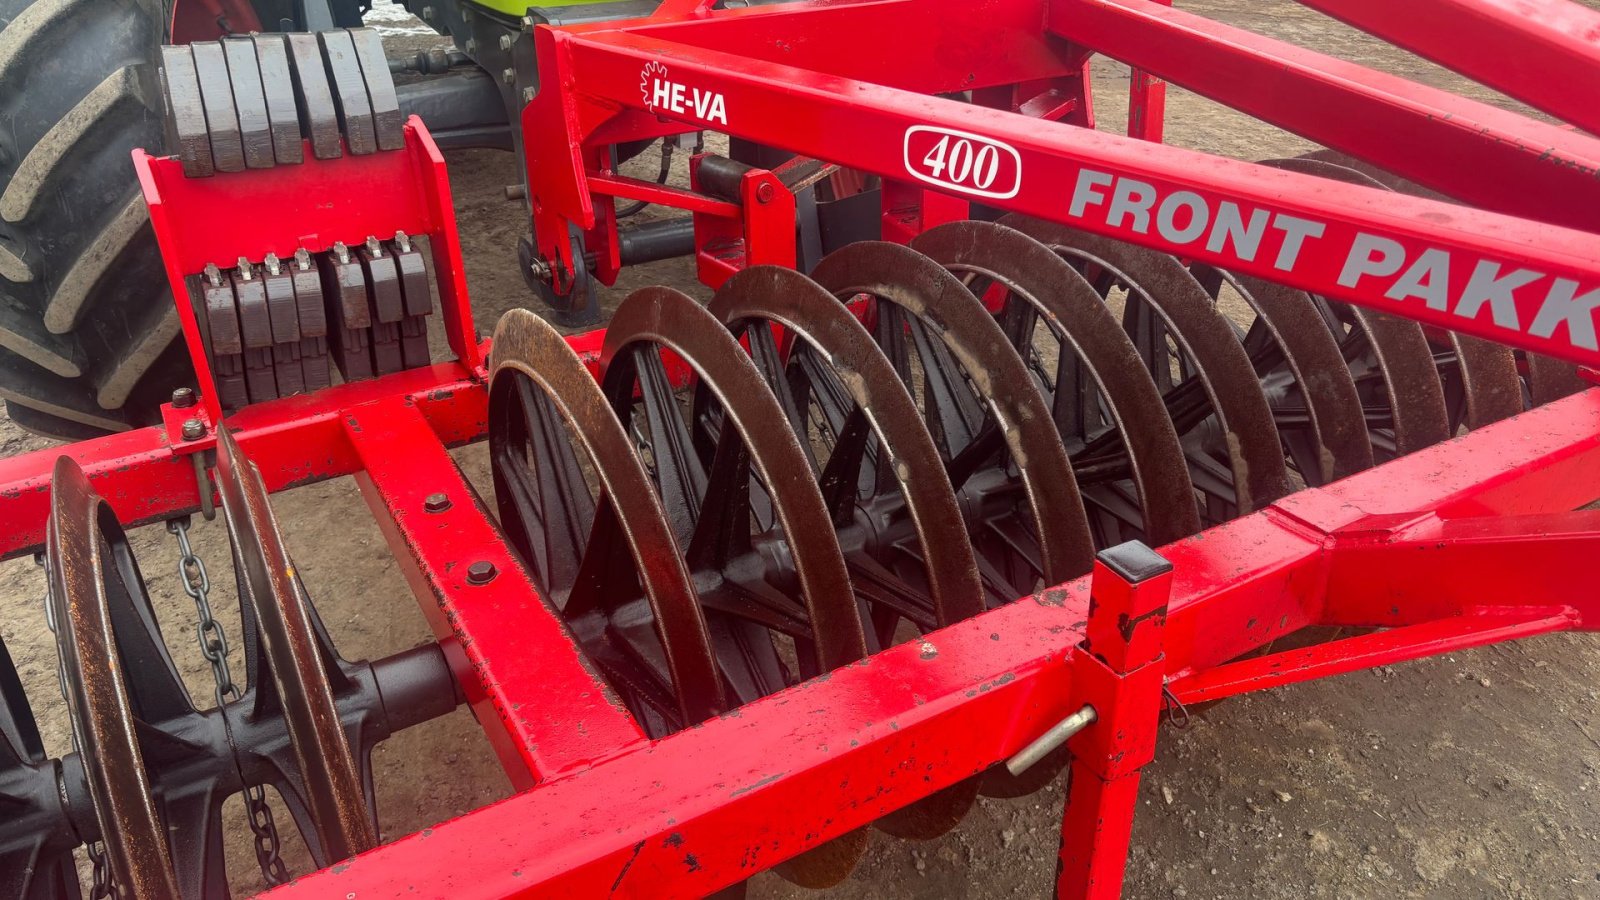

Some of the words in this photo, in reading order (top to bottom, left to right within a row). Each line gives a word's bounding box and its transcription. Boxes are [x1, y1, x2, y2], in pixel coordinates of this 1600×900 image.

[653, 79, 728, 125] HE-VA
[923, 135, 999, 189] 400
[1068, 168, 1326, 272] FRONT
[1336, 232, 1600, 352] PAKK
